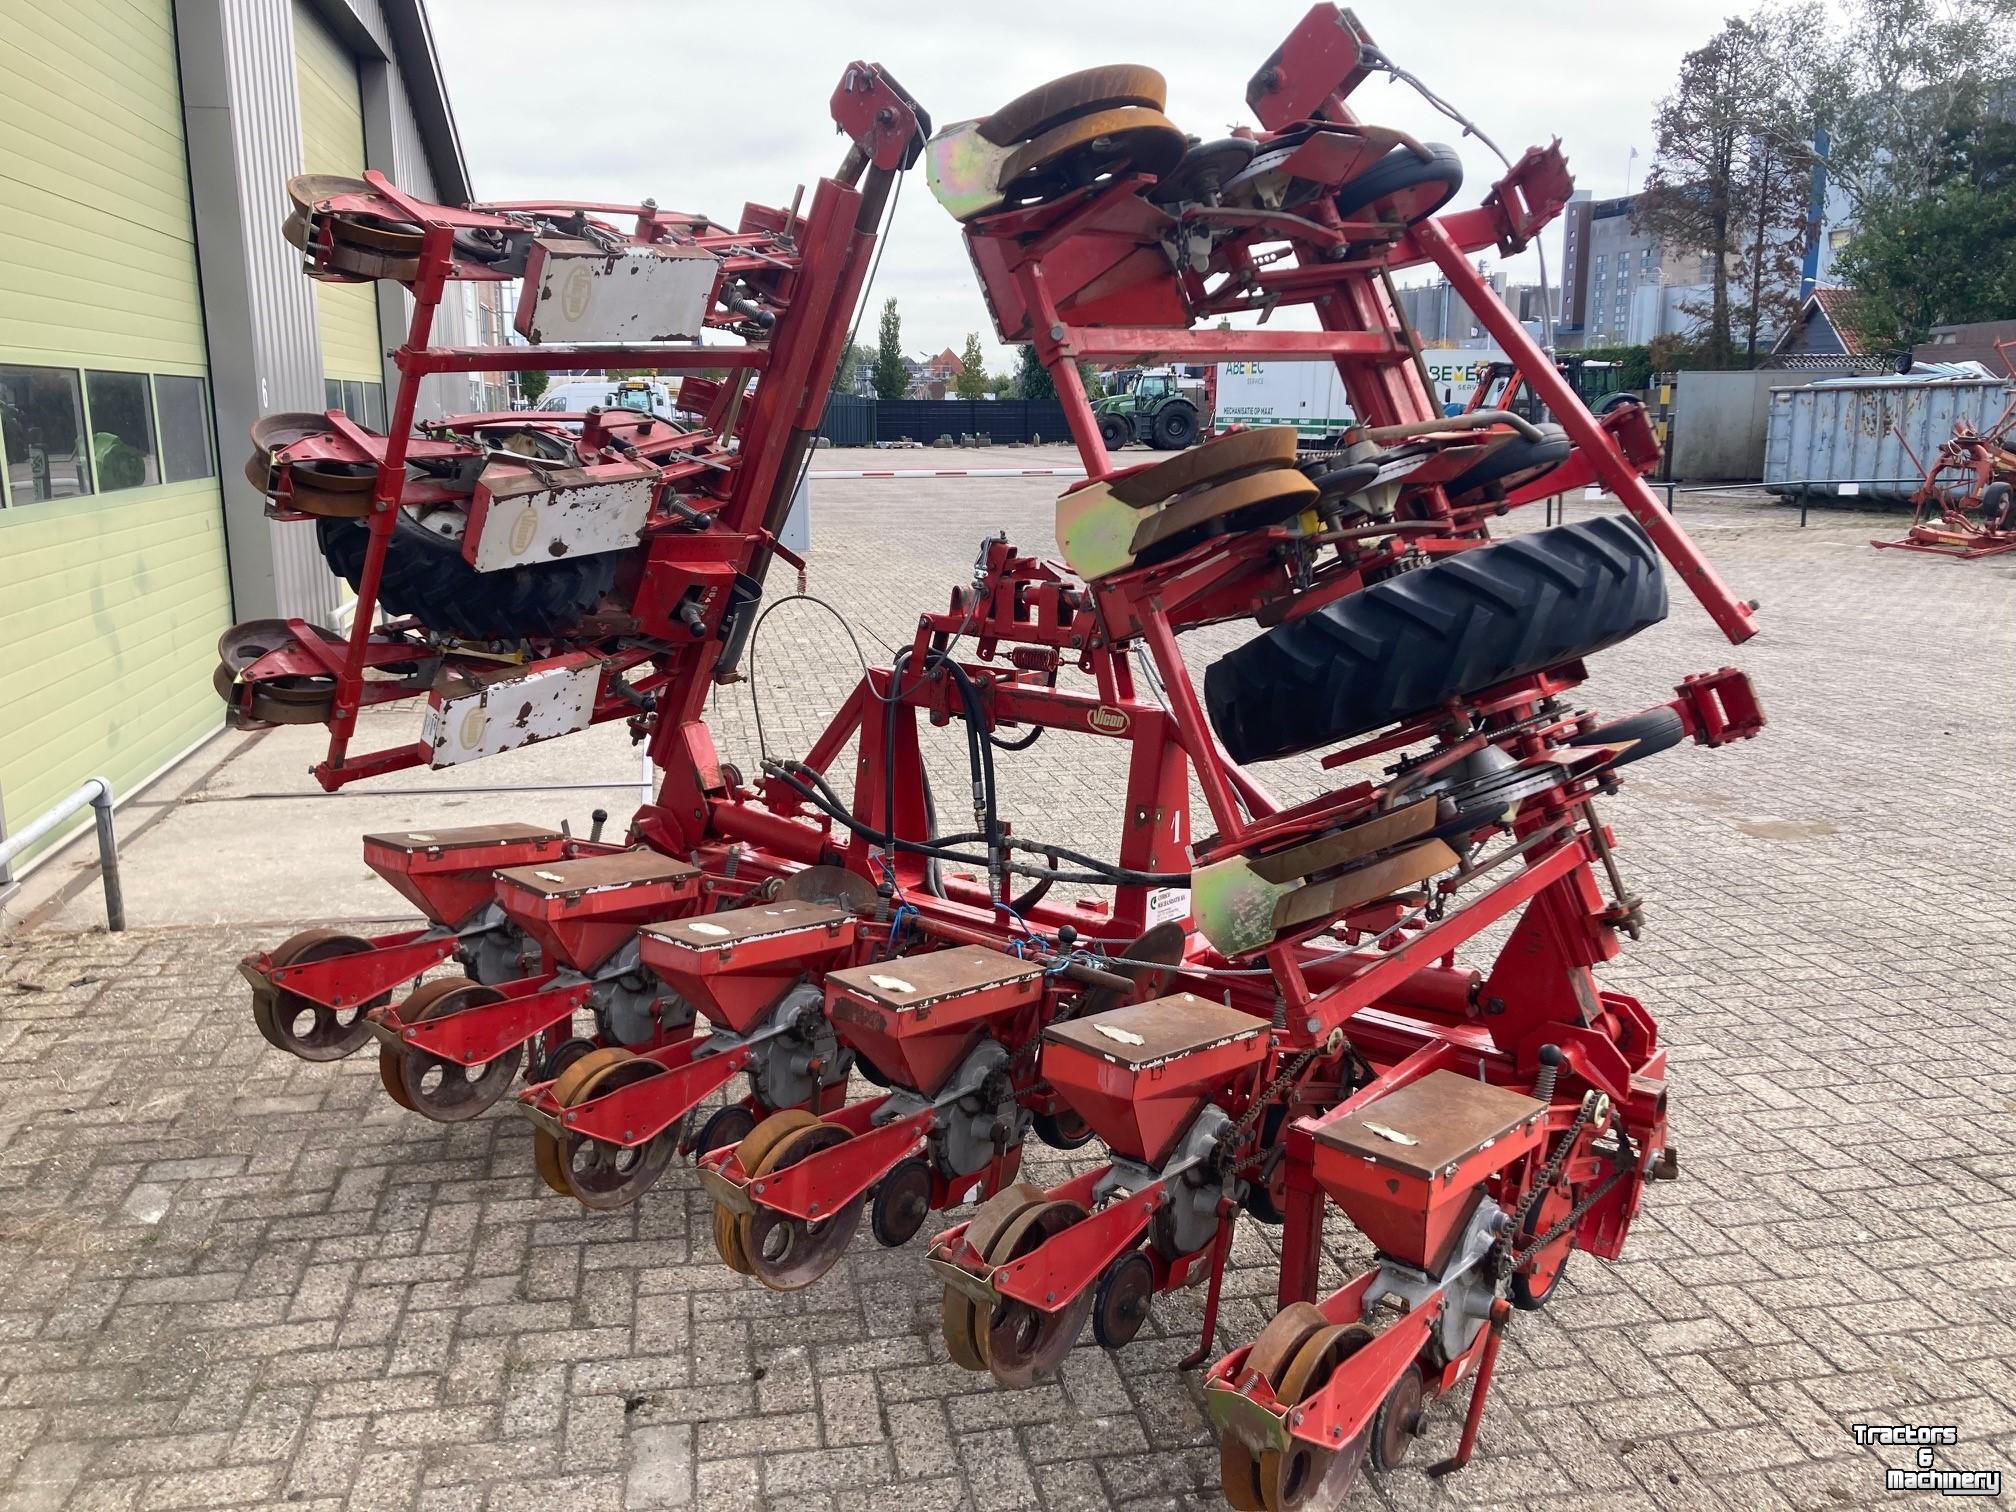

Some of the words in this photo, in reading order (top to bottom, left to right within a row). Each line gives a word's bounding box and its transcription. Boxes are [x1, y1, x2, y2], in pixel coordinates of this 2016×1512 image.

[261, 377, 269, 408] 6
[1223, 407, 1254, 415] MECHANISATIE
[1254, 407, 1260, 415] OP
[1260, 407, 1274, 415] MAAT
[1093, 705, 1125, 728] Vicon
